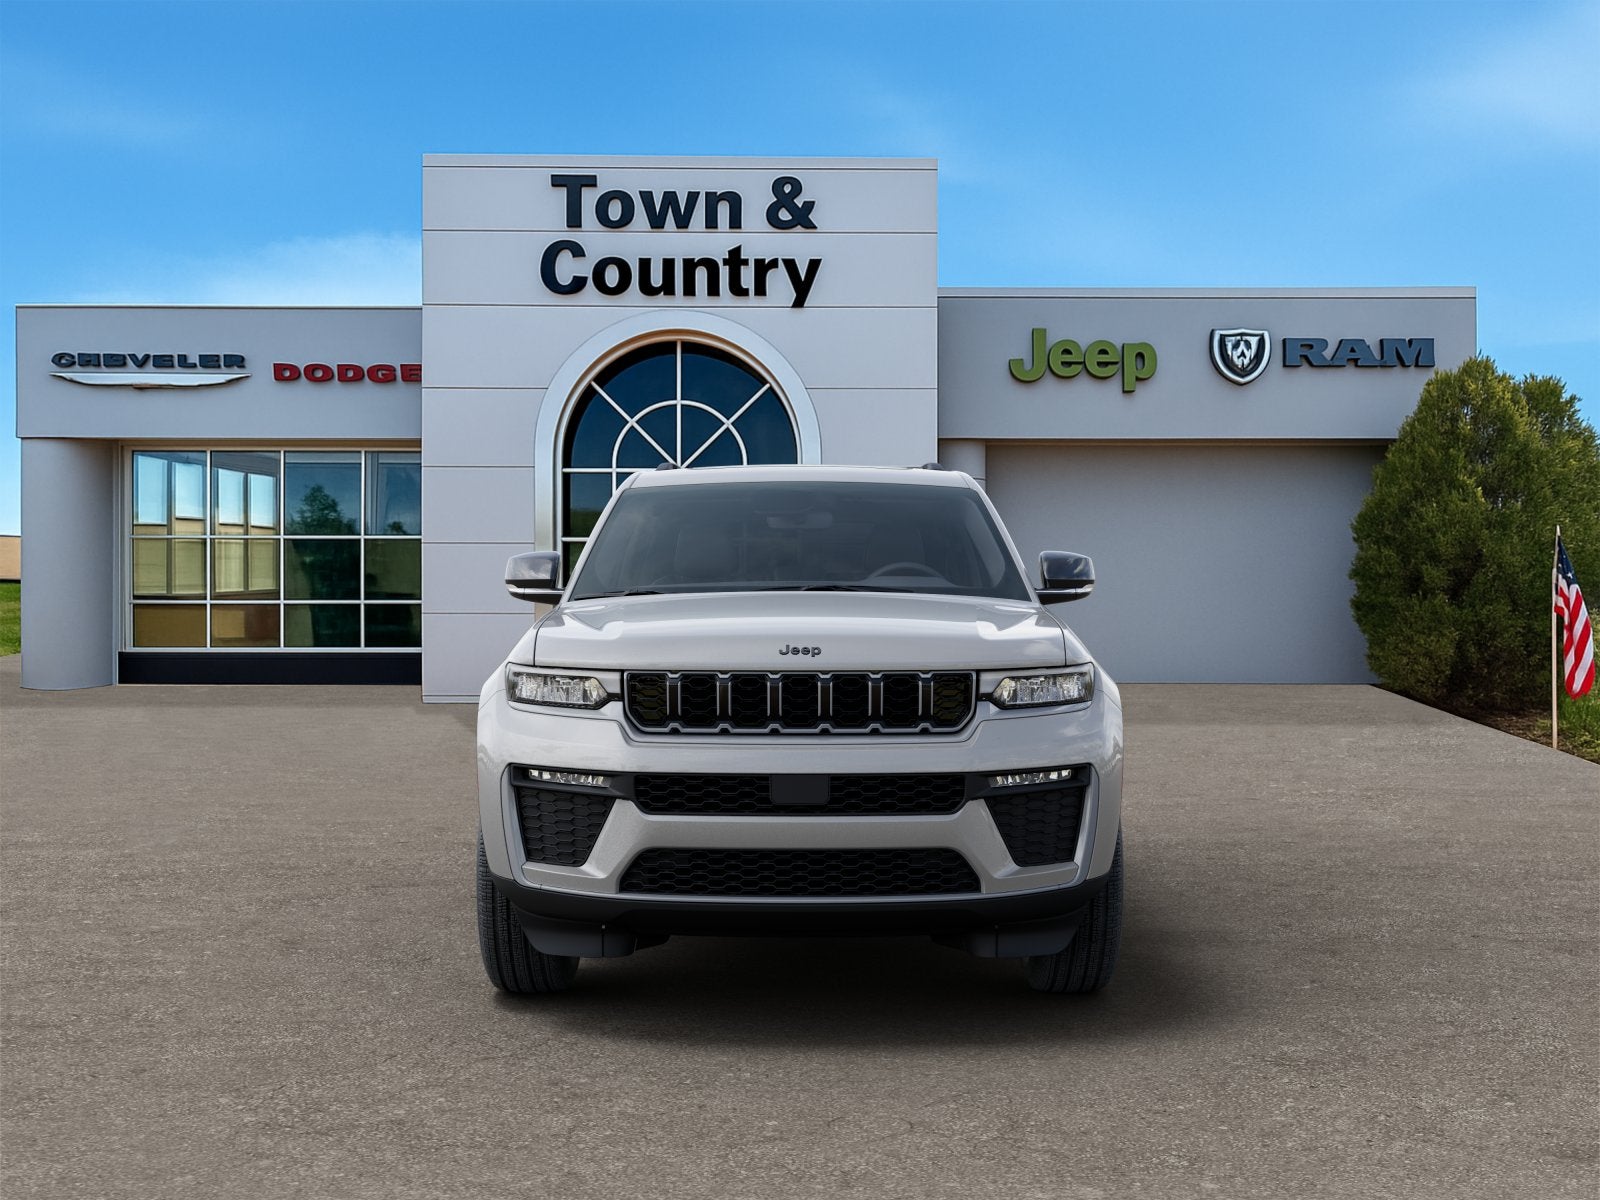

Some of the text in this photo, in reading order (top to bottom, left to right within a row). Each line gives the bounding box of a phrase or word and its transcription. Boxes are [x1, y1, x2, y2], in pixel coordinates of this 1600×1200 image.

[551, 174, 818, 229] Town &
[540, 240, 822, 308] Country
[1009, 328, 1158, 393] Jeep
[1283, 338, 1436, 368] RAM
[779, 644, 822, 657] Jeep
